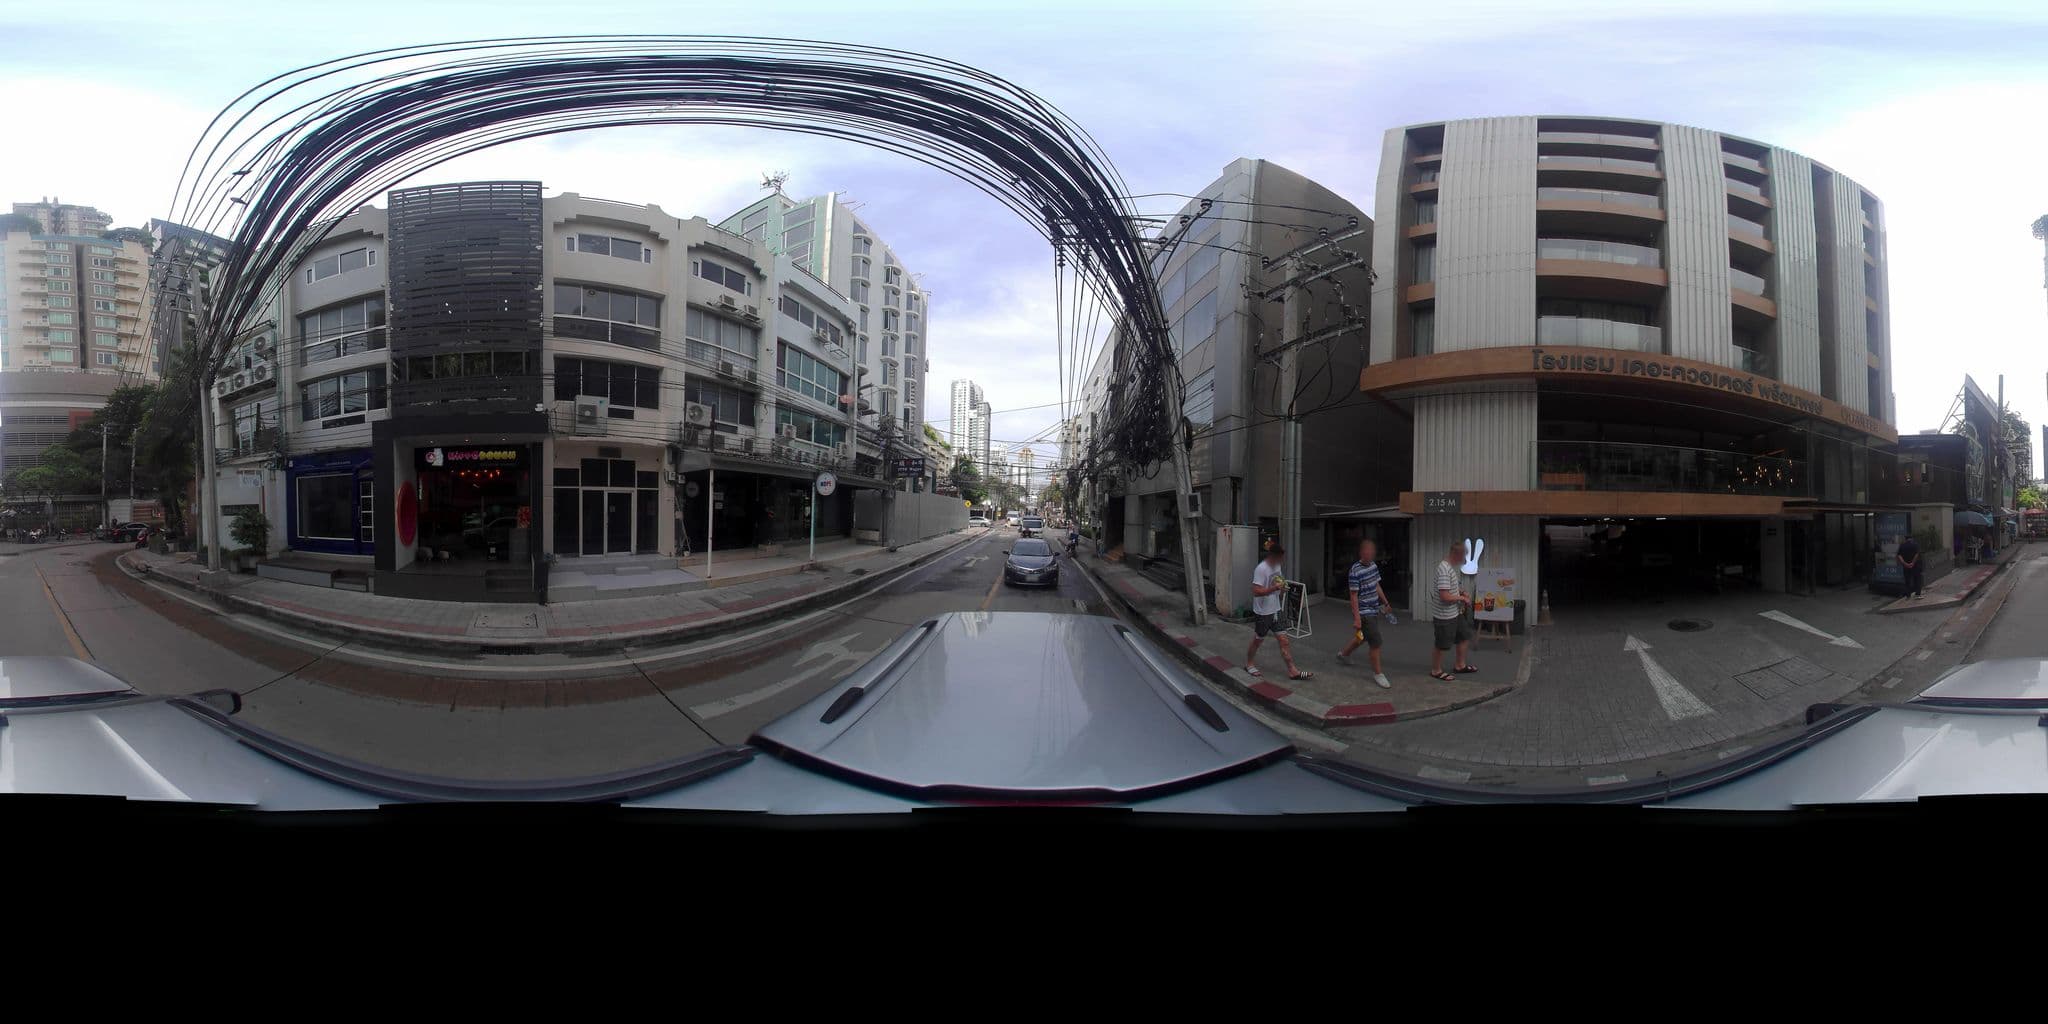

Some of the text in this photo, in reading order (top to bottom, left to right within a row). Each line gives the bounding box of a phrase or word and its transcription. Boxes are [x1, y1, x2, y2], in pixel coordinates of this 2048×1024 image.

[1532, 348, 1615, 373] โรงแรม
[1622, 358, 1754, 394] เดอะควอเตอร์
[1428, 498, 1456, 507] 2.15 M
